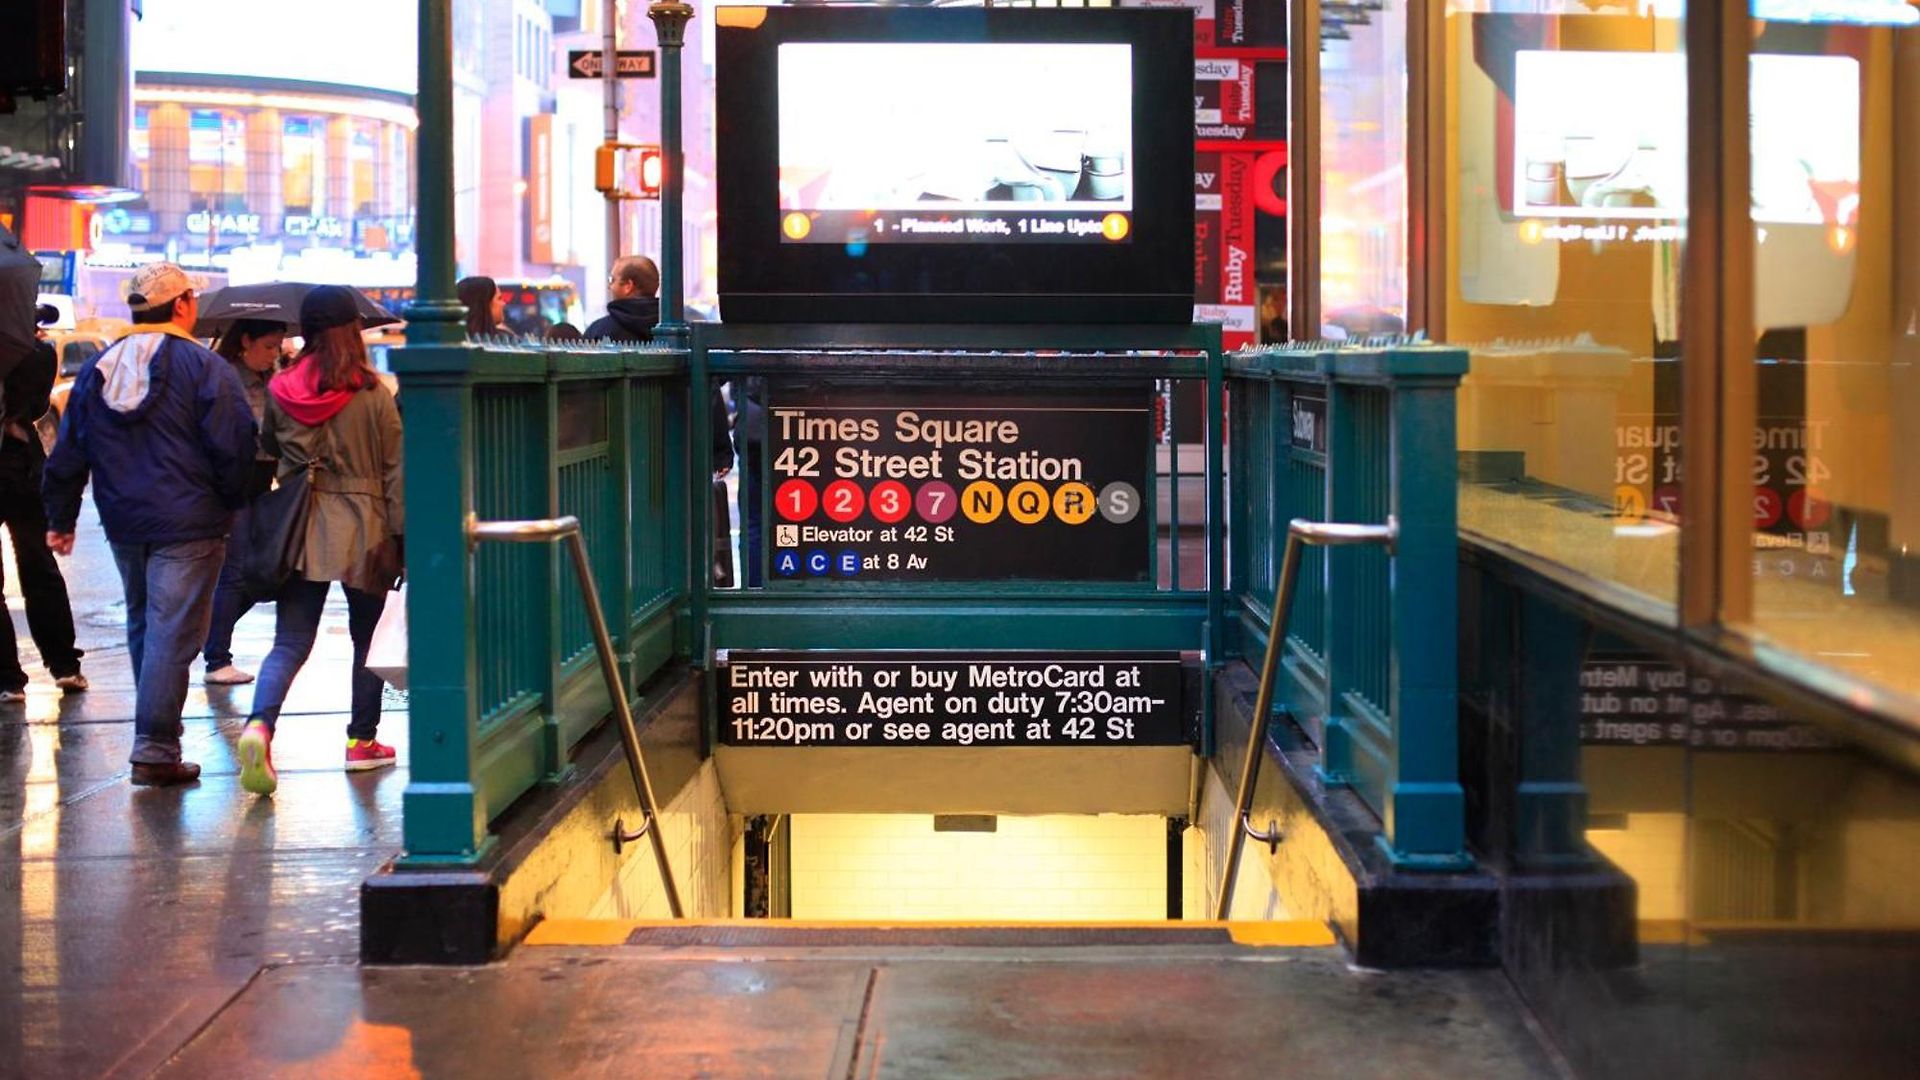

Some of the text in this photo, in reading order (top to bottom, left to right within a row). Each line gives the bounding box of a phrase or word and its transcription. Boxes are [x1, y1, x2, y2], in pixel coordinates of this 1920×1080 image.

[1232, 0, 1244, 43] Tuesda
[581, 58, 603, 70] ON
[1196, 62, 1231, 77] sday
[1239, 65, 1253, 121] Tuesday
[873, 219, 884, 232] 1
[1018, 219, 1027, 232] 1
[1031, 219, 1065, 232] Line
[1224, 156, 1248, 302] Ruby Tuesday
[775, 411, 1019, 448] Times Square
[774, 447, 1082, 480] 42 Street Station
[788, 490, 1129, 515] 1 2 3 7 N Q R S
[803, 526, 954, 542] Elevator at 42 St
[780, 554, 928, 570] A C E at 8 Av
[732, 665, 1140, 693] Enter with or buy MetroCard at
[732, 692, 758, 714] all
[771, 692, 846, 714] times.
[857, 693, 933, 718] Agent
[945, 696, 977, 714] on
[987, 693, 1044, 718] duty
[731, 718, 1135, 746] 11:20pm or see agent at 42 St
